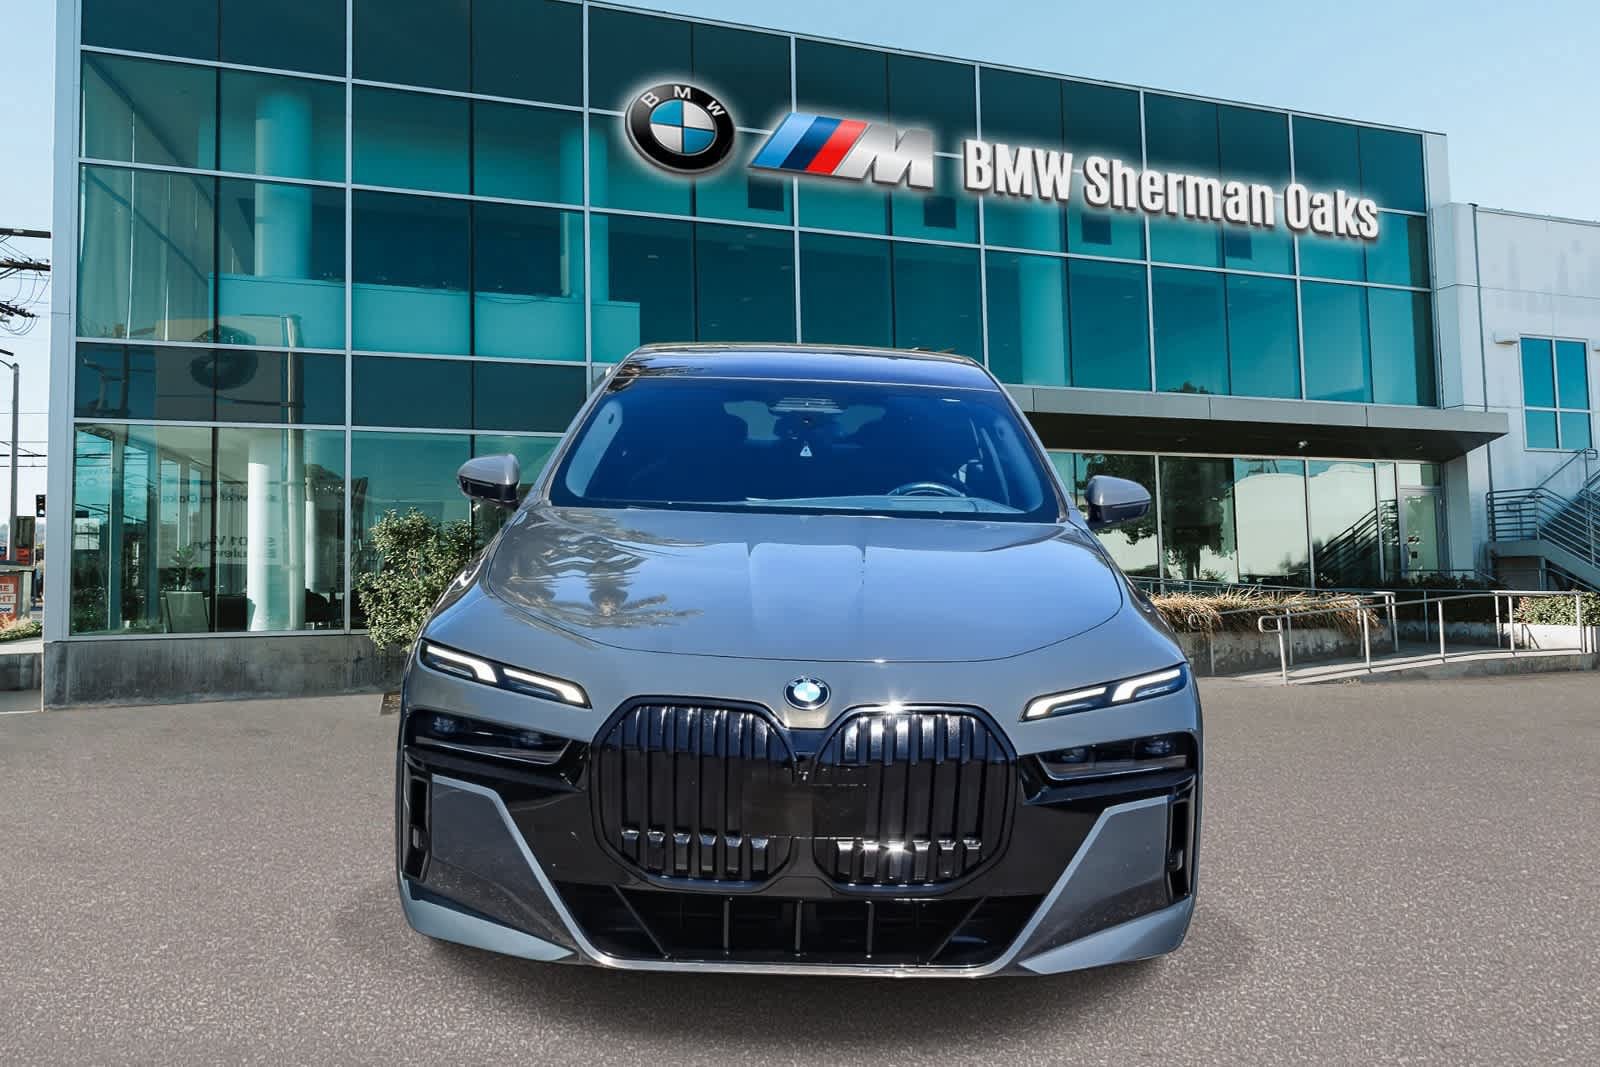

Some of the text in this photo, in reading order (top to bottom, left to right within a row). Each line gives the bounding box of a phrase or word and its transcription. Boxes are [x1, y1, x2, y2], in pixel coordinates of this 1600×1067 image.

[641, 85, 725, 117] BMW
[963, 139, 1379, 239] BMW Sherman Oaks
